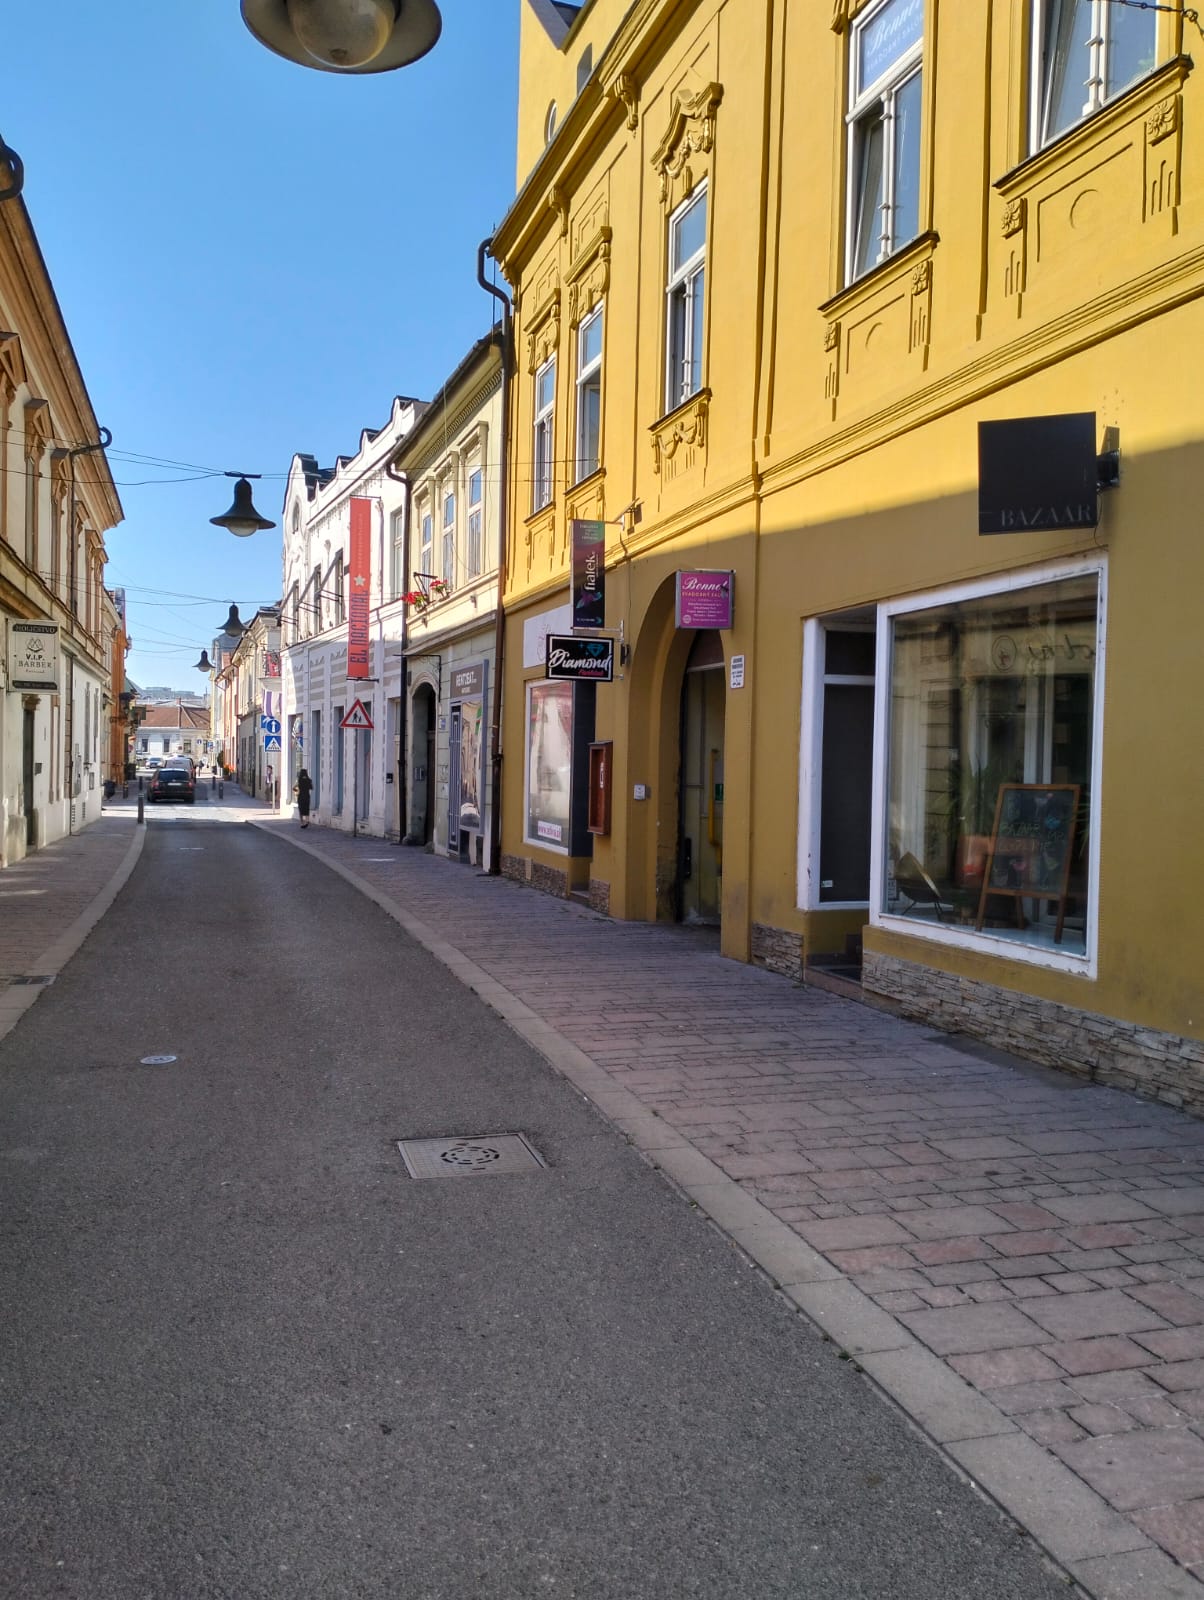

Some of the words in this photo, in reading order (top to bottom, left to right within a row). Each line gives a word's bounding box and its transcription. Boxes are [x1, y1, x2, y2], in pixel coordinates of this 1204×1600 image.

[1001, 504, 1091, 526] BAZAAR
[18, 660, 52, 668] BARBER
[26, 653, 45, 661] V.I.P.
[548, 648, 612, 671] Diamond
